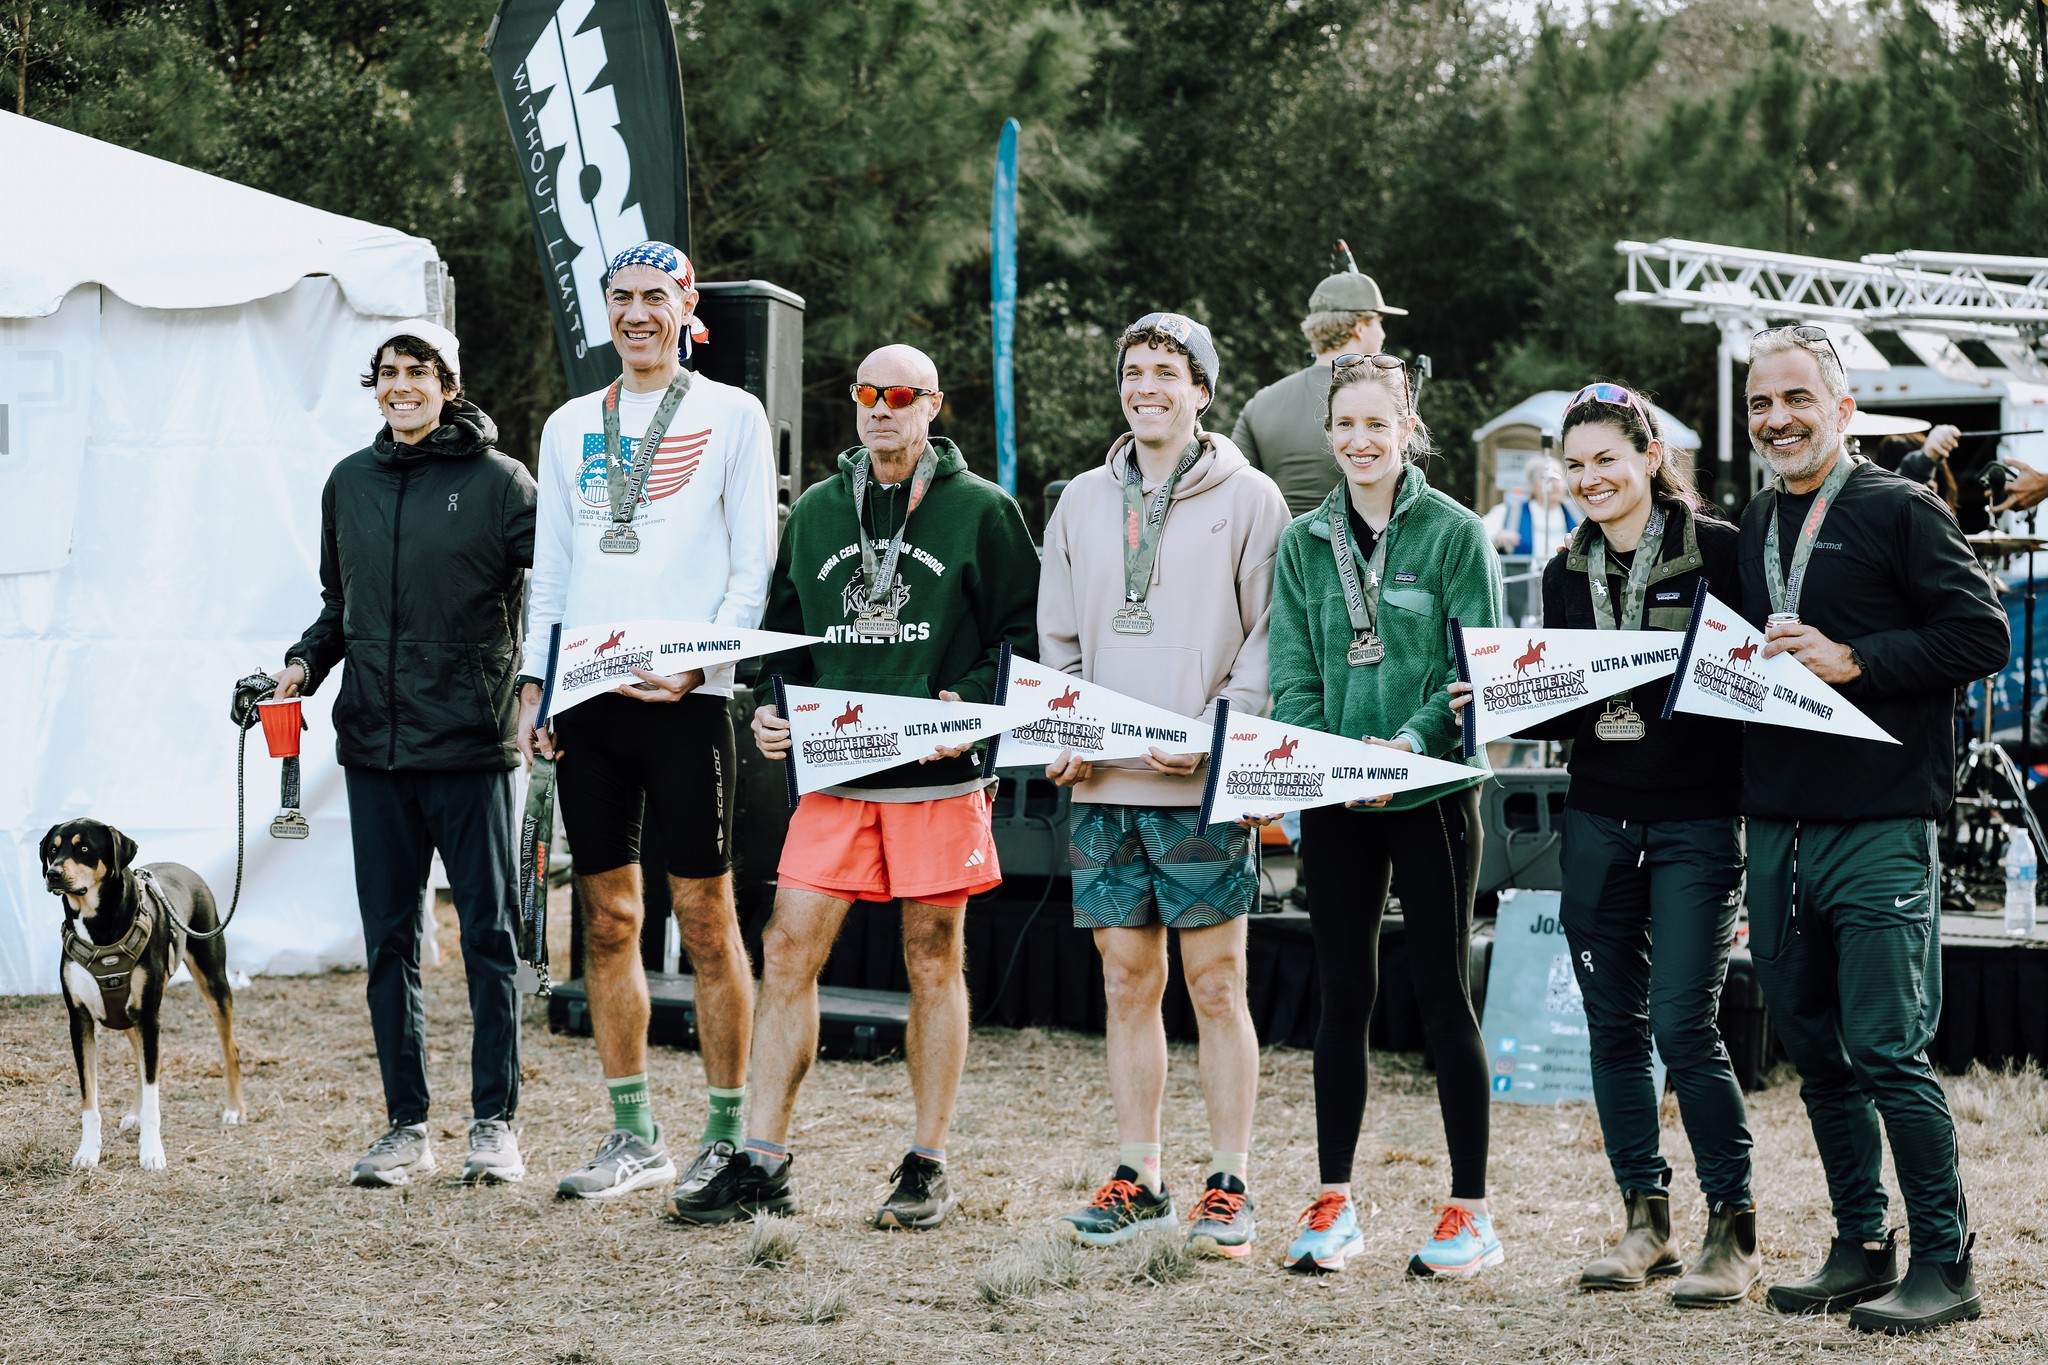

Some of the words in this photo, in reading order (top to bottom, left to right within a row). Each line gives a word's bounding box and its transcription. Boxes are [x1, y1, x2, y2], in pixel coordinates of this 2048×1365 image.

[513, 62, 557, 214] WITHOUT
[547, 237, 588, 359] LIMITS
[618, 477, 641, 521] Award
[634, 428, 661, 474] Winner
[1128, 504, 1139, 550] AARP
[1805, 497, 1827, 542] AARP
[1334, 517, 1350, 568] Winner
[817, 554, 840, 582] TERRA
[839, 543, 861, 560] CEIA
[911, 547, 946, 577] SCHOOL
[1343, 567, 1364, 612] Award
[823, 622, 930, 644] ATHICS
[1704, 618, 1727, 632] AARP
[564, 638, 588, 651] AARP
[660, 643, 694, 655] ULTRA
[697, 640, 741, 652] WINNER
[1471, 644, 1500, 657] AARP
[563, 650, 654, 681] SOUTHERN
[1591, 656, 1629, 673] ULTRA
[1631, 647, 1680, 666] WINNER
[562, 673, 600, 691] TOUR
[1014, 677, 1041, 688] AARP
[1483, 670, 1585, 701] SOUTHERN
[1695, 658, 1769, 700] SOUTHERN
[1484, 694, 1531, 711] TOUR
[1535, 682, 1588, 702] ULTRA
[1694, 670, 1728, 696] TOUR
[1730, 685, 1763, 712] ULTRA
[794, 703, 820, 712] AARP
[1495, 705, 1527, 716] WILMINGTON
[1527, 702, 1546, 711] HEALTH
[1546, 697, 1579, 708] FOUNDATION
[1773, 684, 1797, 706] ULTRA
[1798, 695, 1834, 721] WINNER
[904, 722, 938, 737] ULTRA
[940, 718, 982, 733] WINNER
[1111, 722, 1142, 738] ULTRA
[1145, 727, 1187, 743] WINNER
[1229, 733, 1257, 741] AARP
[802, 732, 899, 754] SOUTHERN
[1012, 728, 1054, 744] TOUR
[1058, 731, 1104, 750] ULTRA
[804, 750, 849, 764] TOUR
[851, 744, 901, 761] ULTRA
[862, 757, 893, 765] FOUNDATION
[1227, 770, 1325, 786] SOUTHERN
[1331, 767, 1363, 780] ULTRA
[1367, 767, 1408, 780] WINNER
[1226, 783, 1271, 796] TOUR
[1274, 784, 1324, 797] ULTRA
[522, 814, 539, 864] Award
[536, 840, 546, 885] AARP
